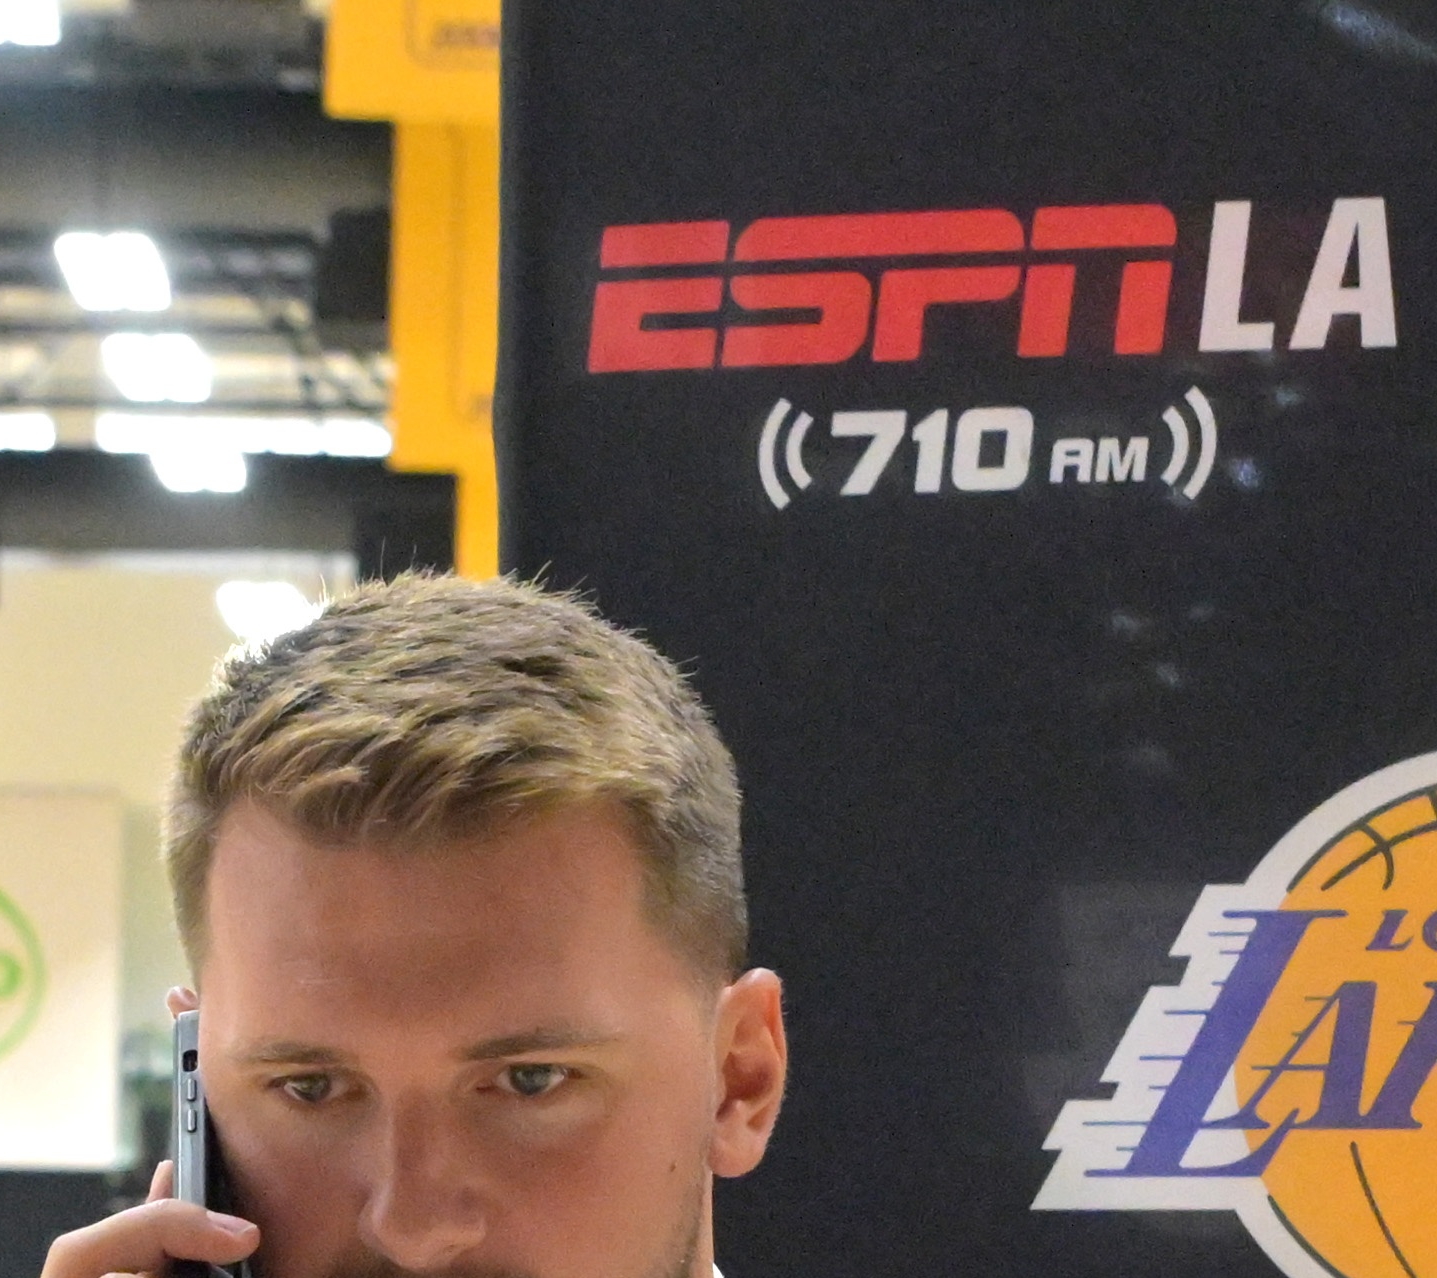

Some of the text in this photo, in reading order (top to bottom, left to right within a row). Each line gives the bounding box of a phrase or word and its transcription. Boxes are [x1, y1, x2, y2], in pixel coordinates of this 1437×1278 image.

[585, 196, 1398, 374] ESPN LA
[829, 406, 1149, 495] 710 AM
